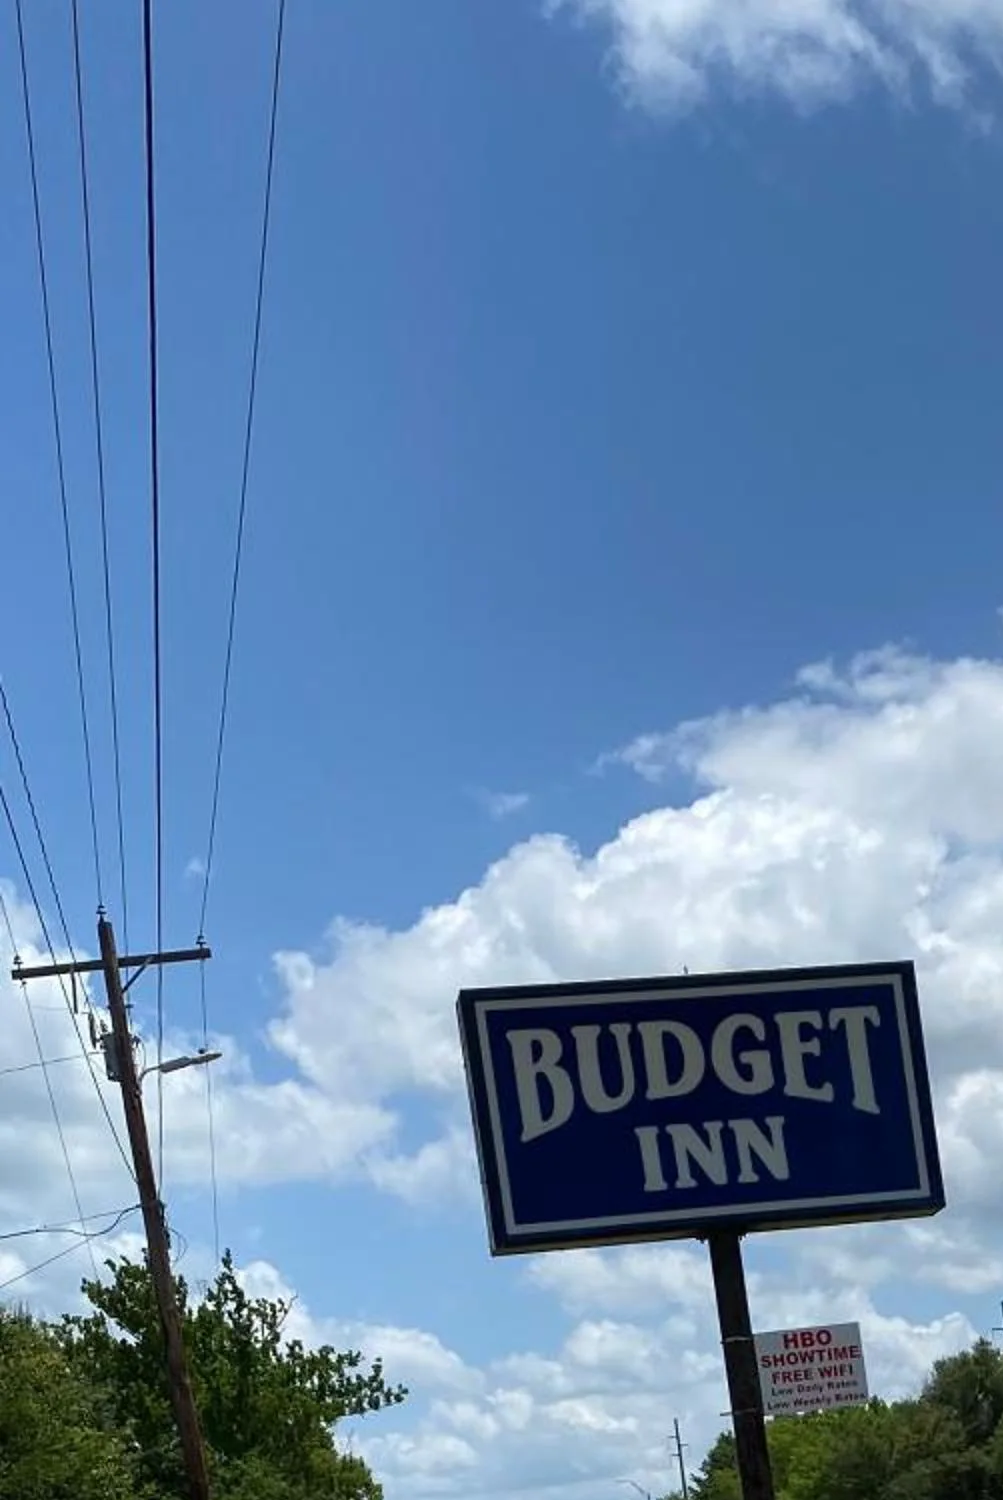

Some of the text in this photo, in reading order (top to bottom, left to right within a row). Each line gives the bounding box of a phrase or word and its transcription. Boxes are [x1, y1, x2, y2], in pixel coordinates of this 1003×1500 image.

[506, 1005, 881, 1143] BUDGET
[634, 1115, 790, 1192] INN
[783, 1329, 832, 1349] HBO
[760, 1345, 861, 1368] SHOWTIME
[771, 1363, 853, 1385] FREE WIFI
[771, 1387, 793, 1396] Low
